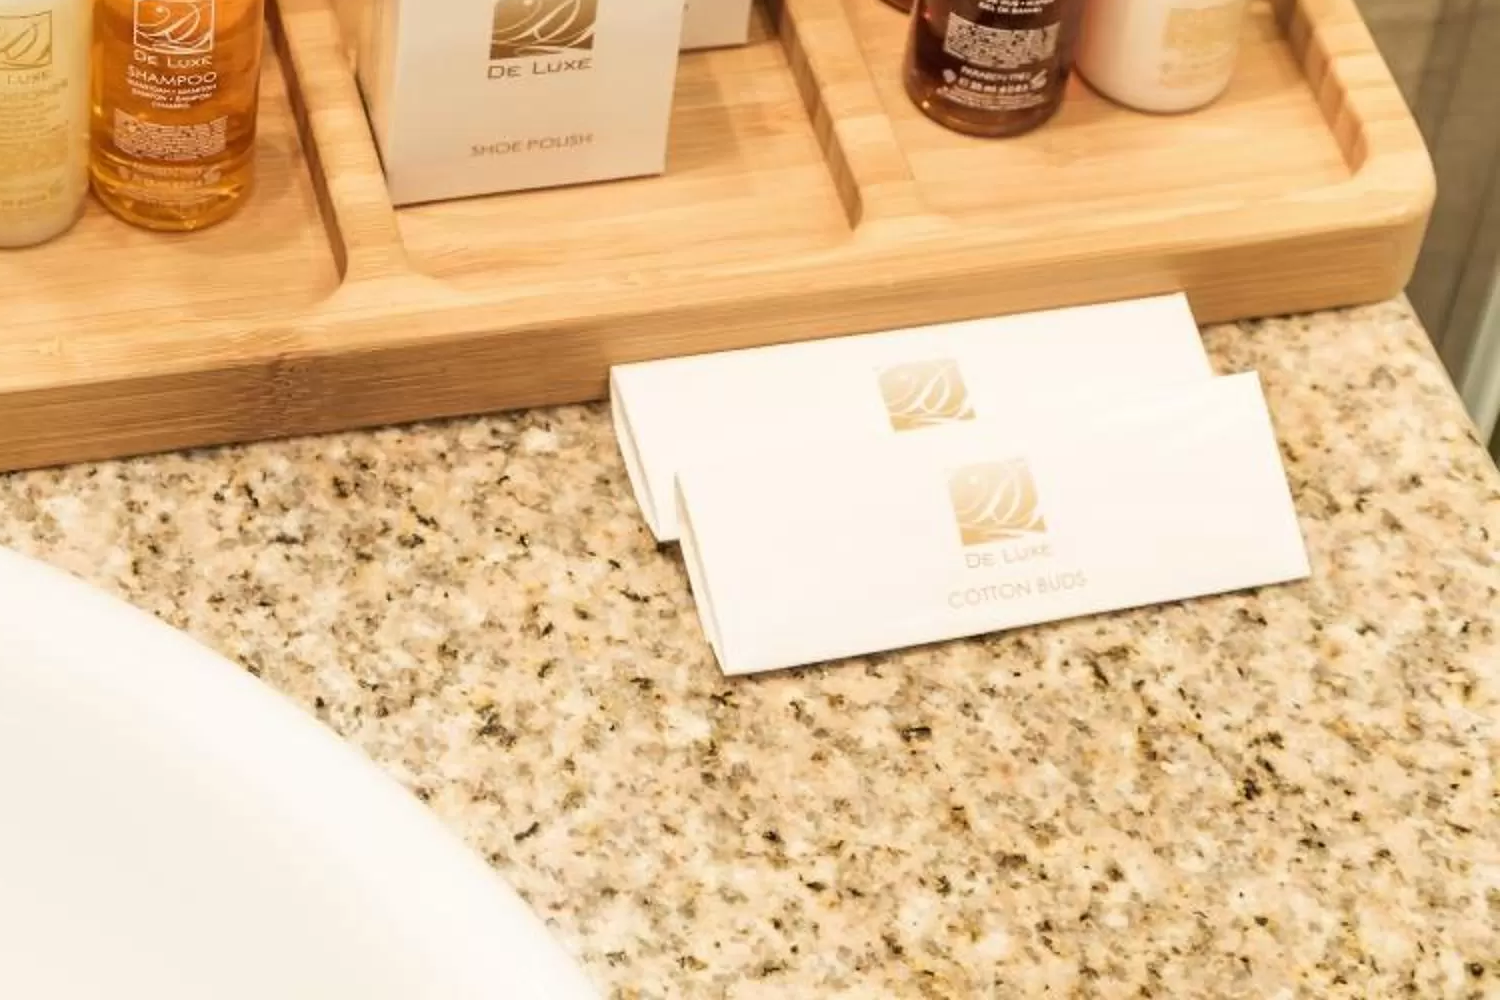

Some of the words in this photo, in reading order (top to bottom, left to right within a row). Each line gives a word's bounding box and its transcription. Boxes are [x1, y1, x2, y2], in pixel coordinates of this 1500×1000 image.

[133, 48, 157, 66] DE
[166, 55, 213, 69] LUXE
[487, 64, 522, 80] DE
[532, 57, 593, 75] LUXE
[127, 63, 218, 87] SHAMPOO
[470, 140, 522, 157] SHOE
[526, 133, 594, 151] POLISH
[964, 552, 996, 569] DE
[1002, 544, 1052, 564] LUXE
[947, 581, 1032, 610] COTTON
[1037, 569, 1089, 595] BUDS
